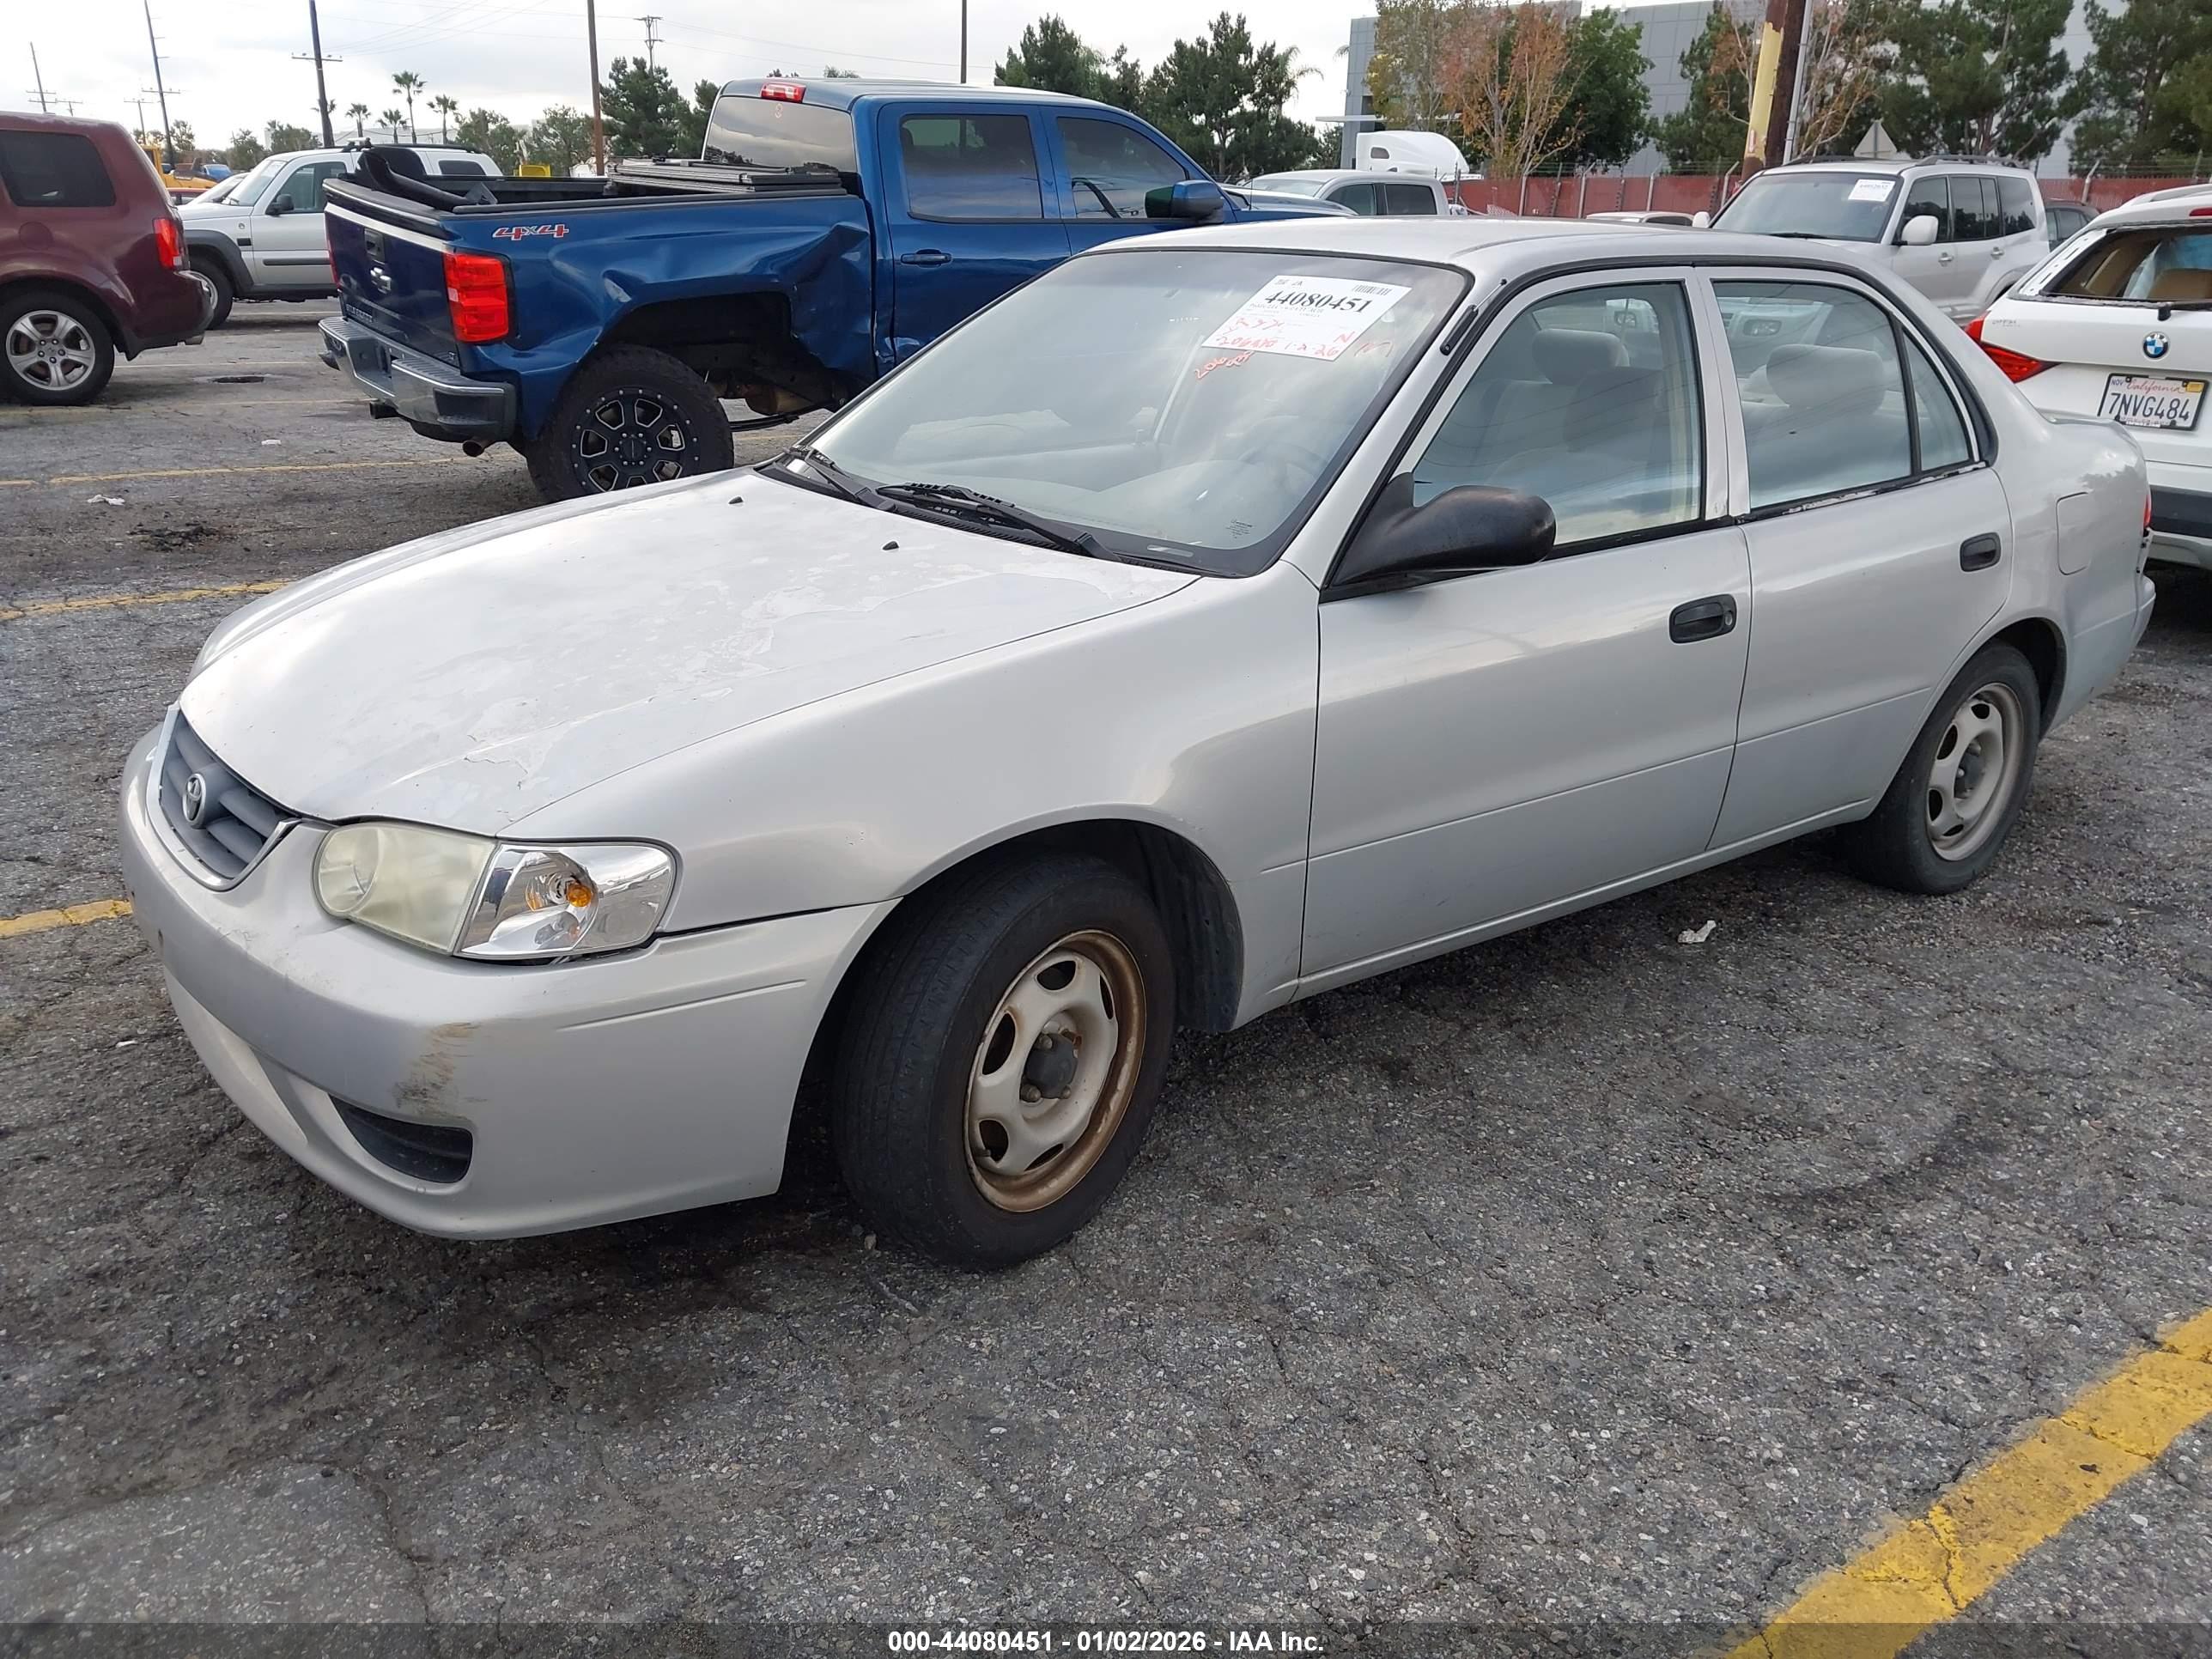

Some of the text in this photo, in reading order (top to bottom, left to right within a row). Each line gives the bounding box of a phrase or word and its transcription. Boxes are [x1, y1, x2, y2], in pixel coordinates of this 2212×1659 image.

[1264, 291, 1373, 313] 44080451
[2126, 379, 2187, 394] California
[2108, 392, 2191, 422] 7NVG484
